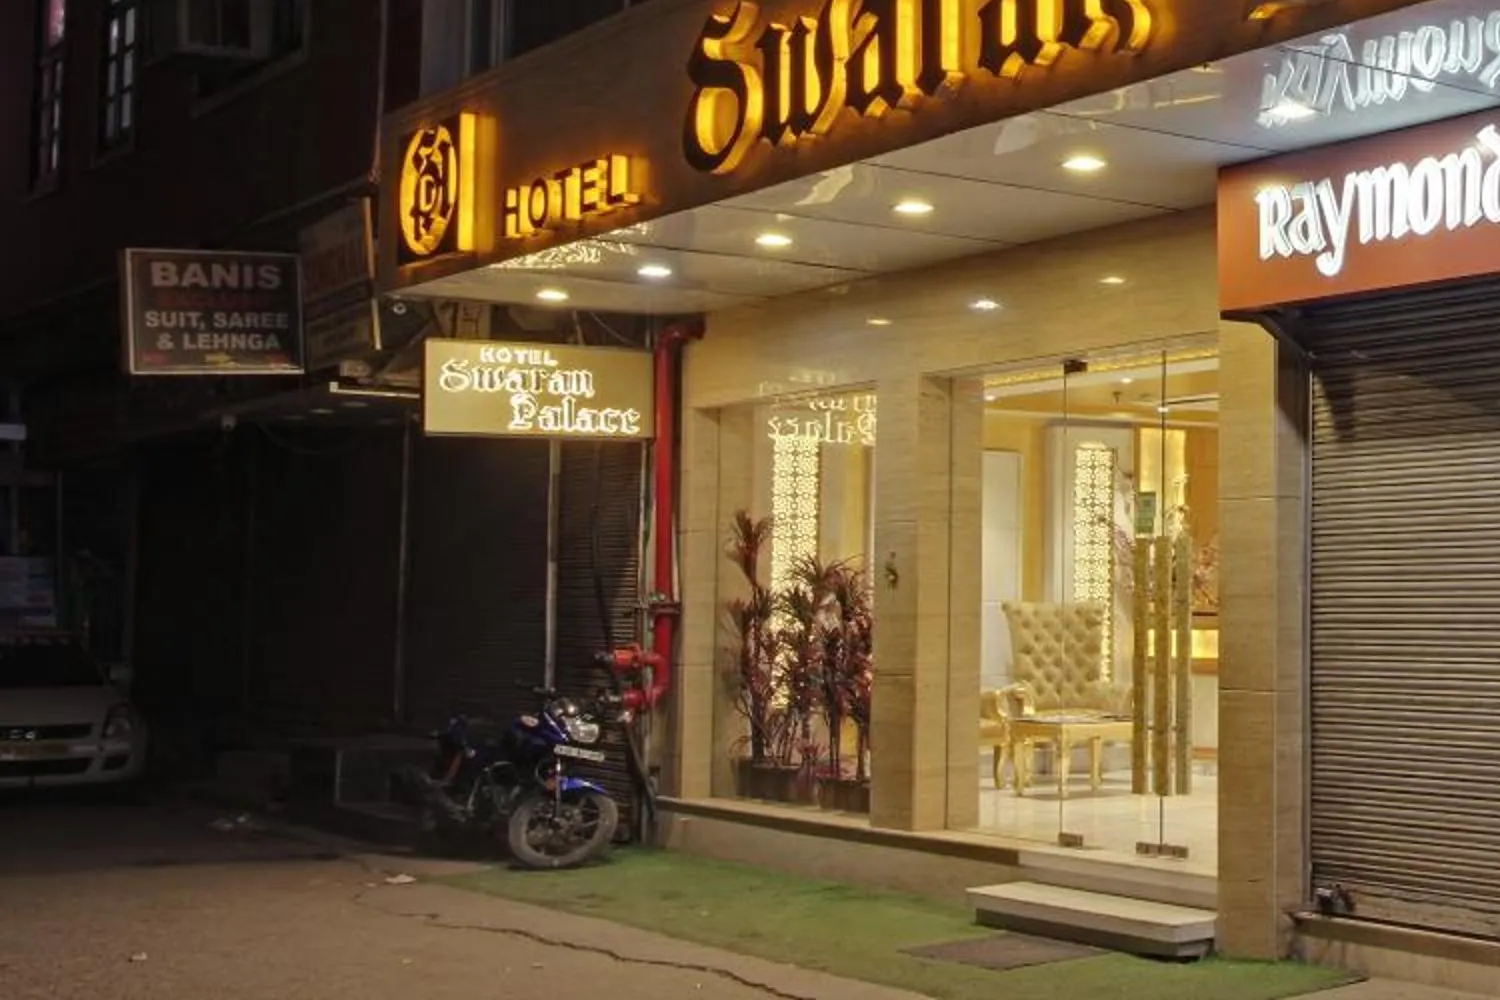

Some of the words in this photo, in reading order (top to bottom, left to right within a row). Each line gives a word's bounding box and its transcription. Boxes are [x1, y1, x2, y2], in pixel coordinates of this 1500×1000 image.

[503, 153, 641, 239] HOTEL
[150, 260, 282, 290] BANIS
[145, 311, 206, 331] SUIT,
[213, 311, 289, 330] SAREE
[156, 333, 175, 350] &
[183, 332, 281, 351] LEHNGA
[479, 346, 559, 367] HOTEL
[439, 358, 596, 399] Swaran
[507, 392, 641, 435] Palace
